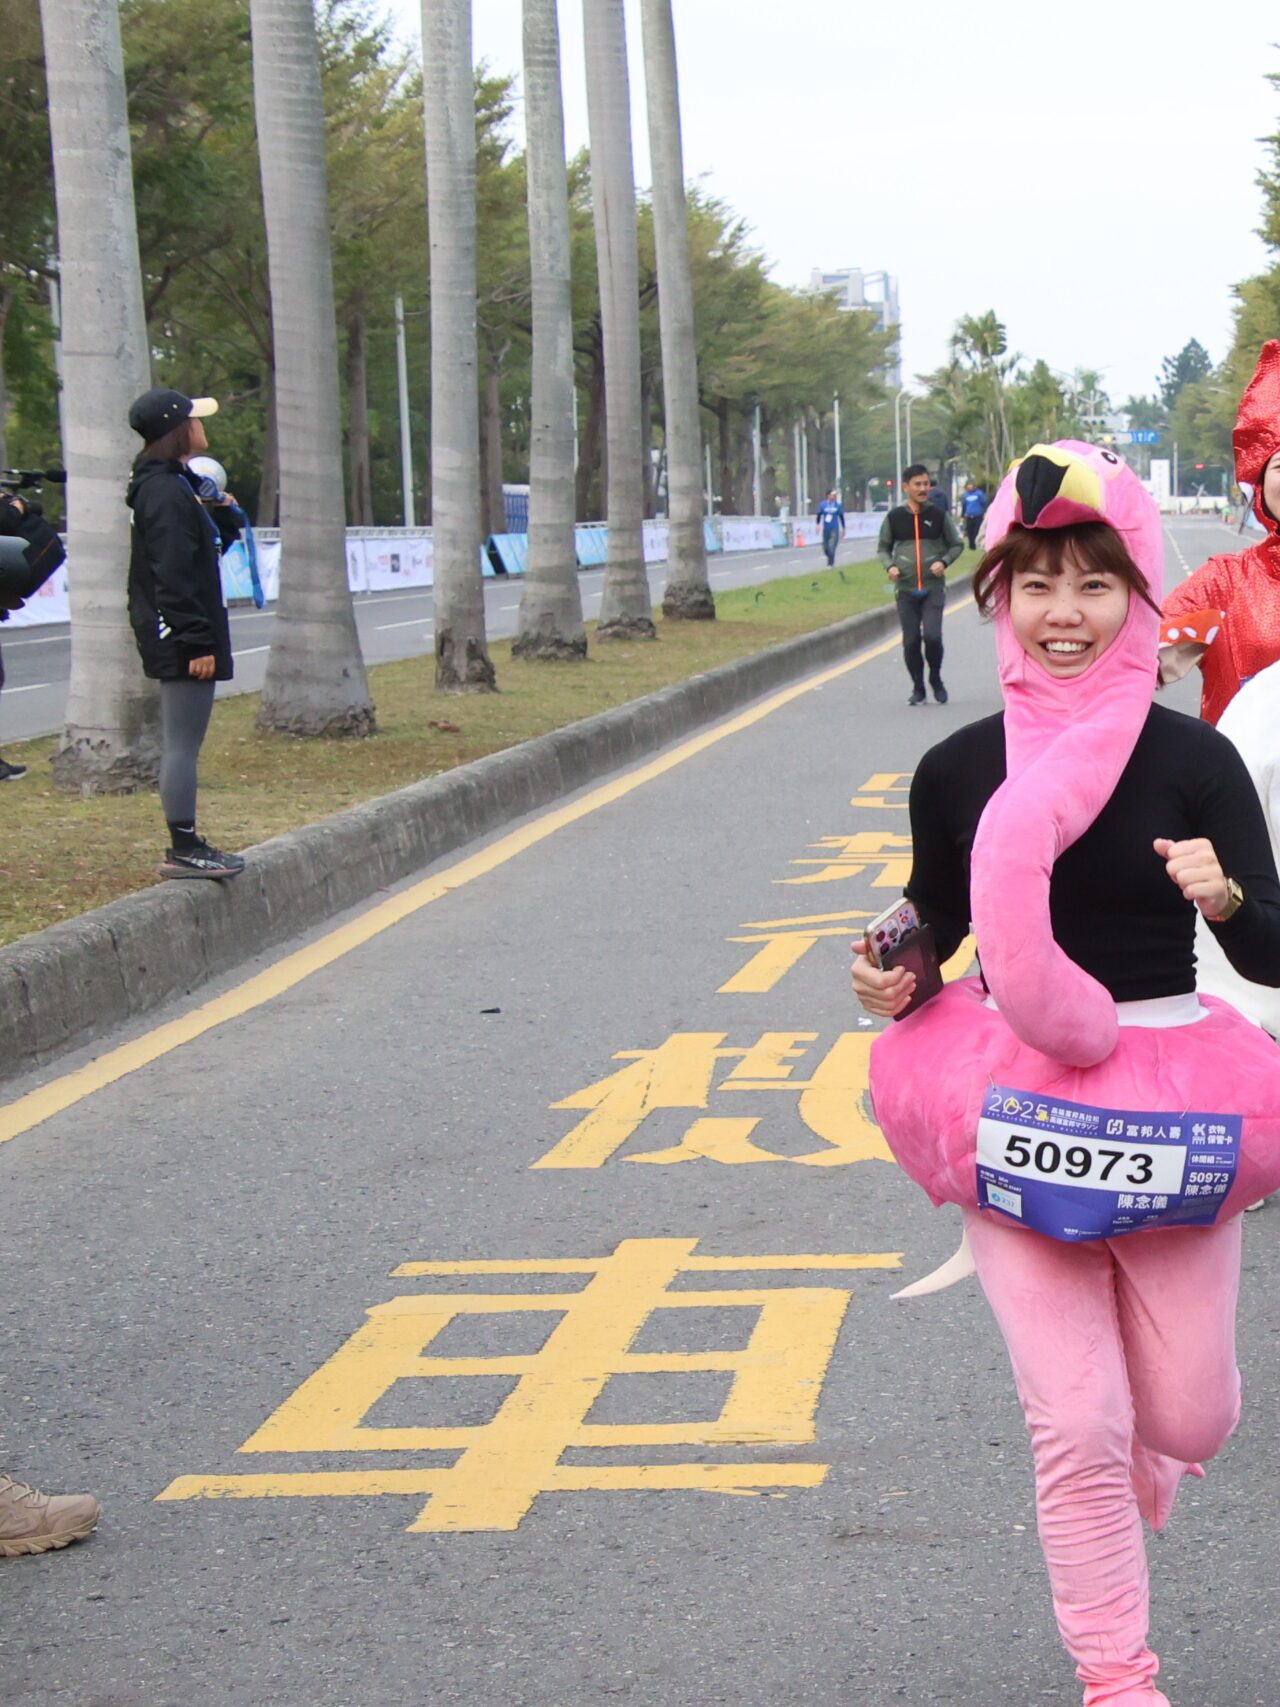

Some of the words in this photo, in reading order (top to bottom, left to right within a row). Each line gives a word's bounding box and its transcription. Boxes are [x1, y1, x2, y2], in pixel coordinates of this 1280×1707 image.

[988, 1094, 1048, 1121] 2025
[1126, 1124, 1181, 1140] 富邦人壽
[1208, 1124, 1226, 1136] 衣物
[1004, 1134, 1154, 1185] 50973
[1189, 1172, 1229, 1184] 50973
[1185, 1184, 1226, 1196] 陳念儀
[1117, 1194, 1169, 1210] 陳念儀
